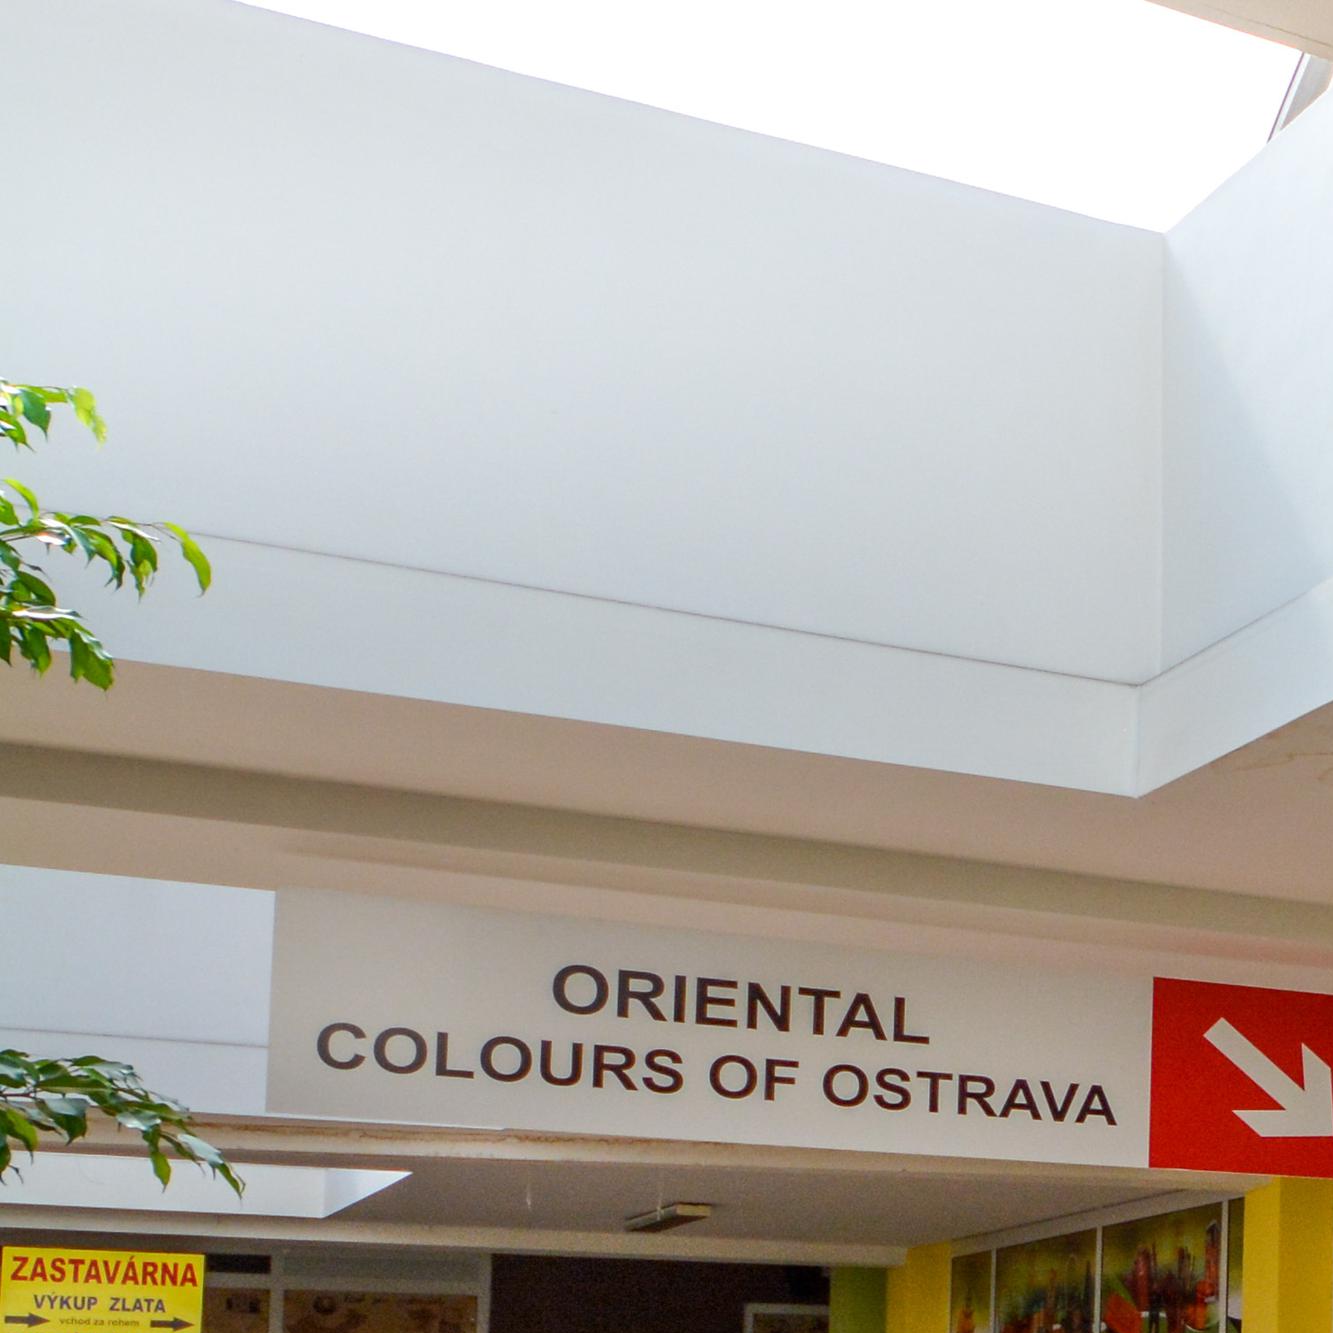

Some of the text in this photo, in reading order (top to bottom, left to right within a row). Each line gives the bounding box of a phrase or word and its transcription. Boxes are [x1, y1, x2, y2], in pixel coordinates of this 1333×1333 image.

[550, 962, 931, 1047] ORIENTAL
[315, 1020, 1119, 1127] COLOURS OF OSTRAVA
[10, 1255, 198, 1288] ZASTAVÁRNA
[33, 1291, 166, 1313] VÝKUP ZLATA
[59, 1317, 91, 1326] vchod
